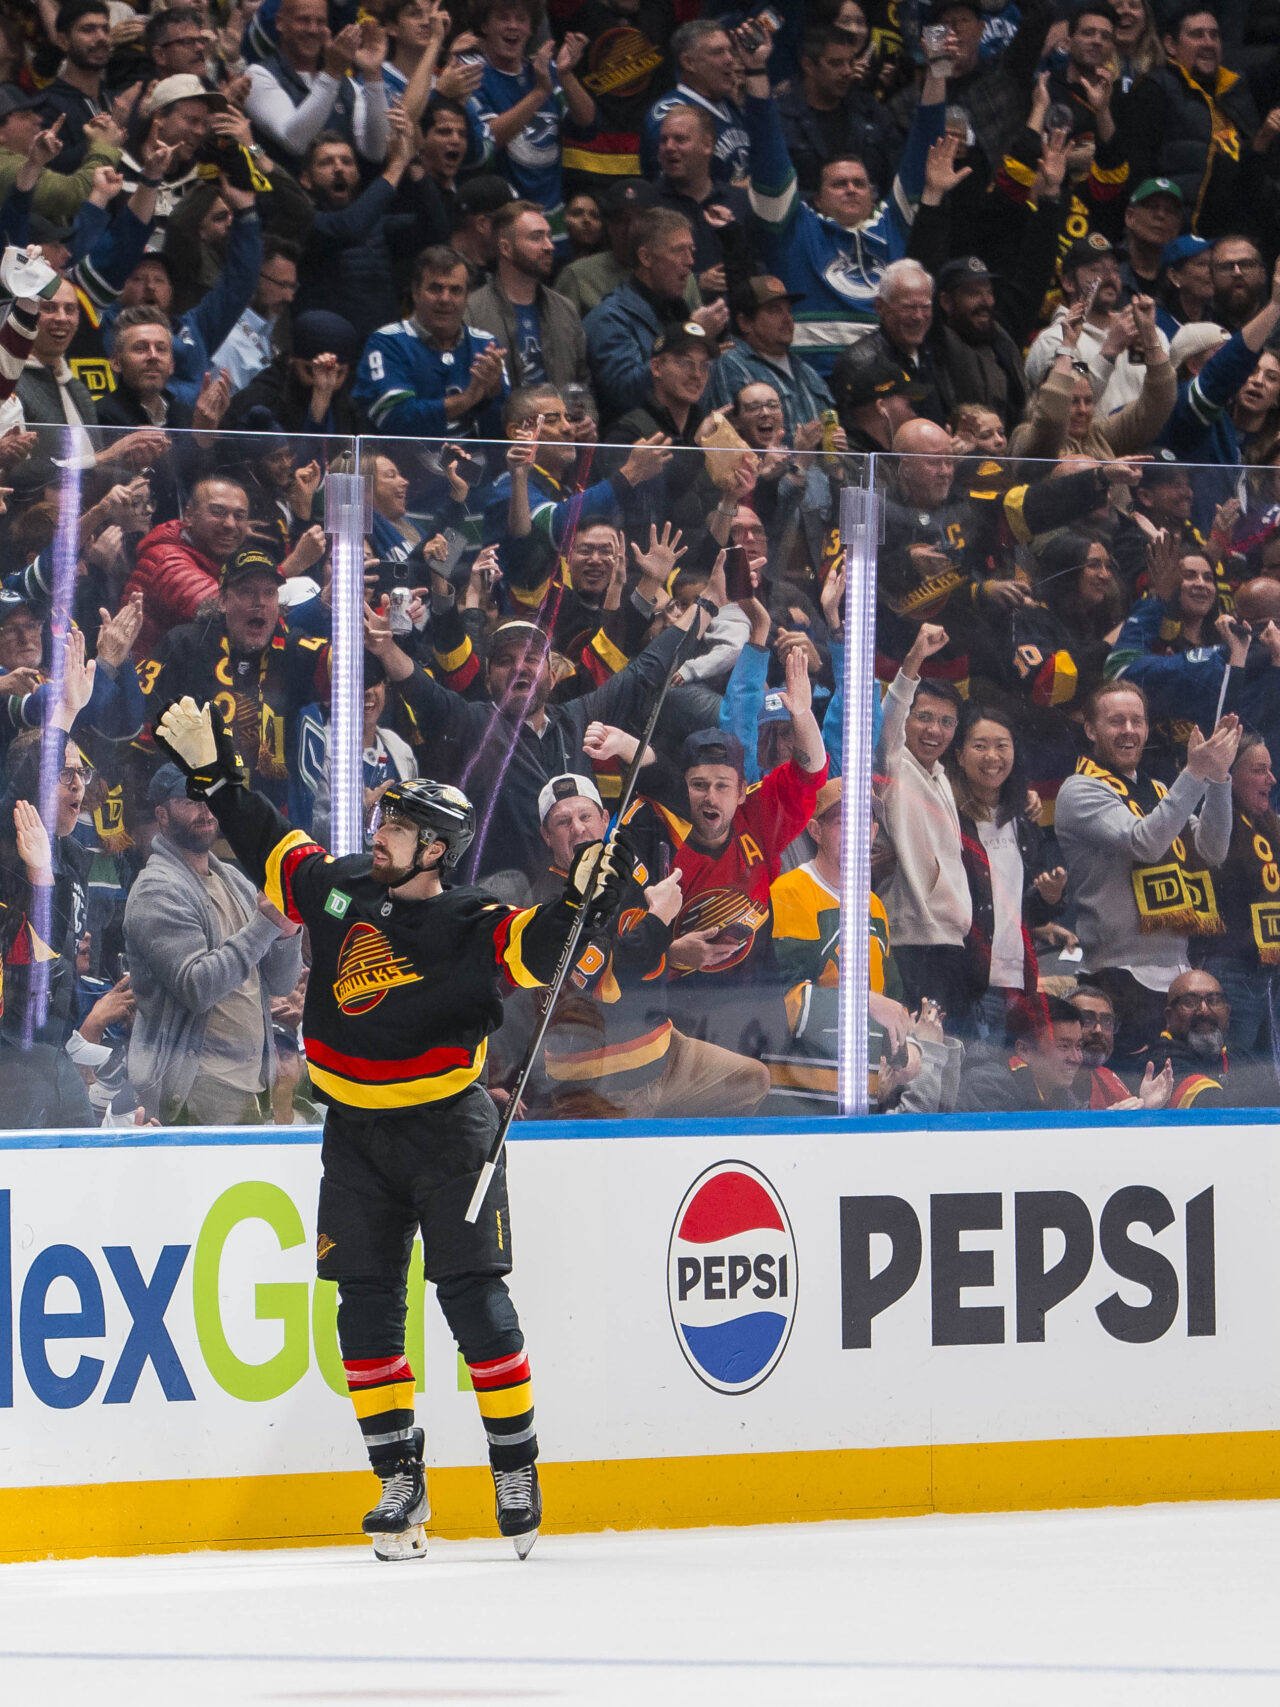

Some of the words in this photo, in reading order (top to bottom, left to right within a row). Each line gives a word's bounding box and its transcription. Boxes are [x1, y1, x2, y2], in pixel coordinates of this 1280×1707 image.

[82, 371, 107, 390] TD
[740, 834, 765, 867] A
[330, 892, 348, 914] TD
[1148, 877, 1181, 902] TD
[332, 961, 424, 1006] CANUCKS
[677, 1253, 789, 1301] PEPSI
[839, 1184, 1216, 1350] PEPSI
